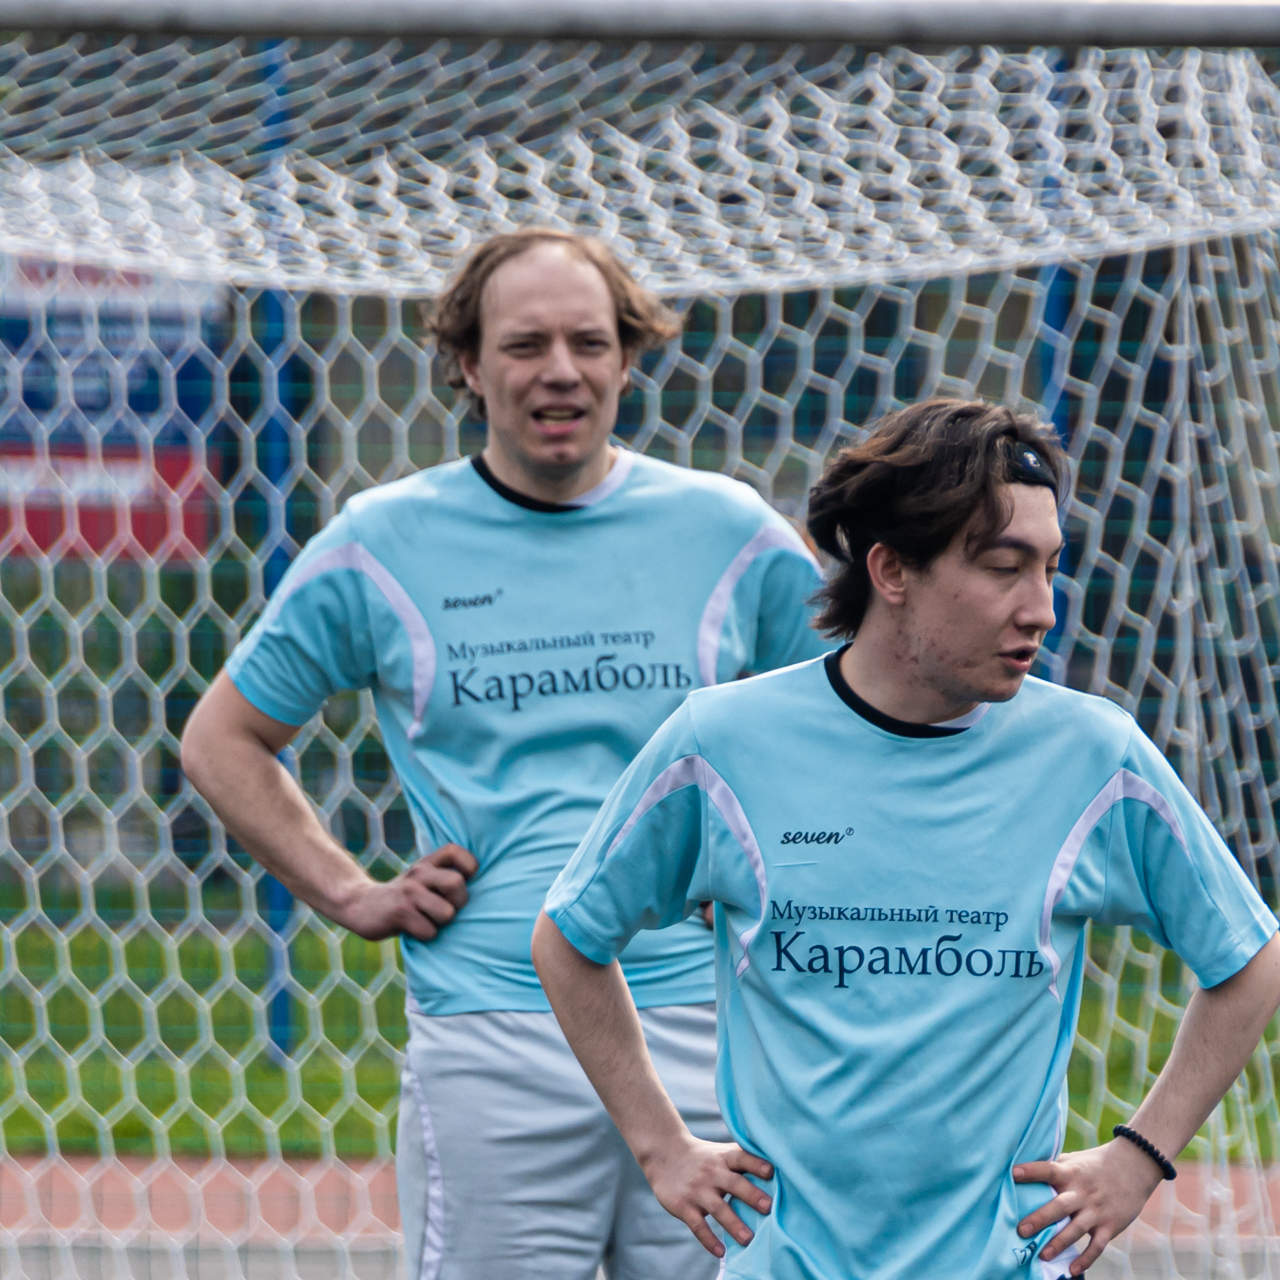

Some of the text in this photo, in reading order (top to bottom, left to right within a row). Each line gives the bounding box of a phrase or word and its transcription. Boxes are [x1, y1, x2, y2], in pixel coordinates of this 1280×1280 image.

[447, 629, 655, 663] Музыкальный театр
[449, 653, 691, 711] Карамболь
[770, 900, 1008, 931] Музыкальный театр
[770, 931, 1044, 988] Карамболь
